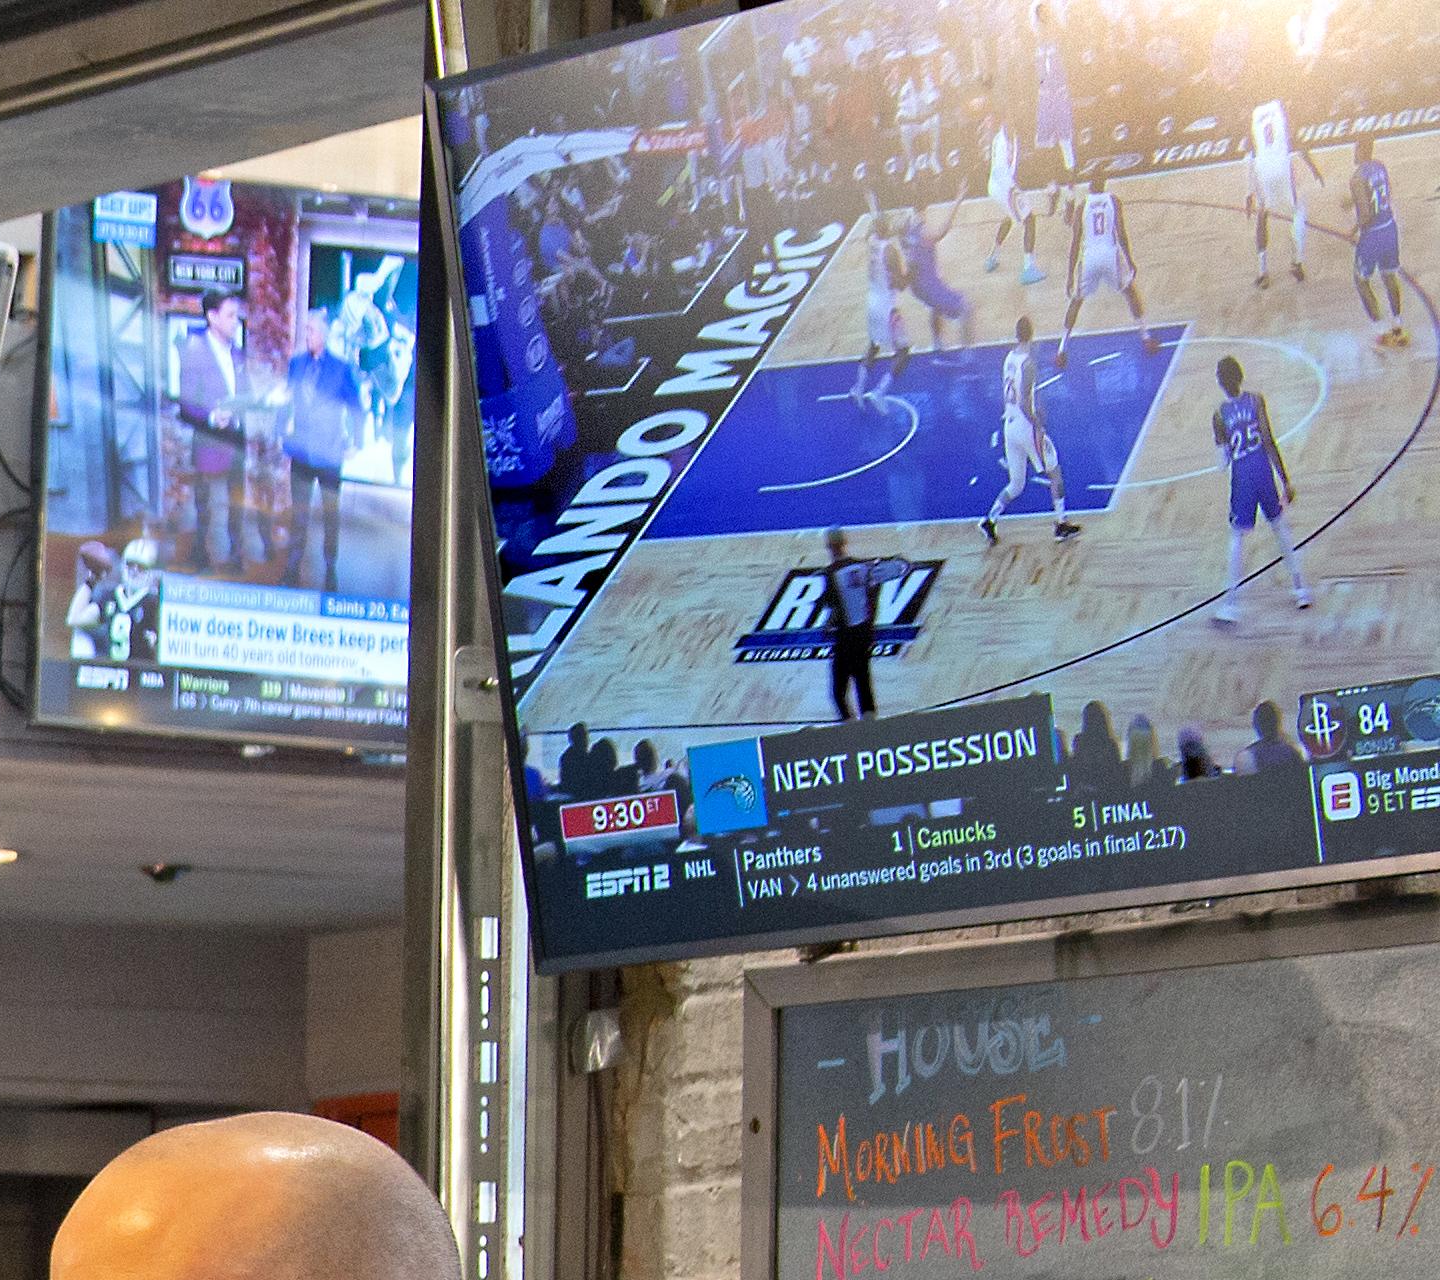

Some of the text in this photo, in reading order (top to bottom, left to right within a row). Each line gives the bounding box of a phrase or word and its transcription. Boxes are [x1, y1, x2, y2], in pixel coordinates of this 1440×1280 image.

[502, 408, 710, 692] LANDO
[653, 221, 845, 397] MAGIC
[1230, 422, 1261, 460] 25
[199, 586, 261, 606] Divisional
[327, 598, 366, 616] Saints
[369, 601, 389, 620] 20,
[764, 566, 933, 631] RV
[110, 612, 131, 661] 9
[168, 614, 202, 634] How
[207, 618, 242, 638] does
[248, 620, 289, 641] Drew
[292, 622, 335, 646] Brees
[339, 625, 376, 653] keep
[168, 638, 191, 656] Will
[194, 641, 219, 659] turn
[223, 643, 239, 660] 40
[243, 647, 274, 665] years
[278, 648, 296, 665] old
[181, 673, 230, 695] Warriors
[1359, 702, 1392, 735] 84
[773, 726, 1038, 792] NEXT POSSESSION
[1365, 769, 1393, 791] Big
[592, 799, 646, 832] 9:30
[1367, 794, 1380, 815] 9
[1383, 790, 1407, 813] ET
[743, 800, 1154, 872] Panthers 1 Canucks 5 FINAL
[685, 858, 717, 881] NHL
[749, 825, 1187, 901] VAN 4 unanswered goals in 3rd (3 goals in final 2:17)
[817, 1112, 977, 1201] MORNING
[989, 1093, 1118, 1176] FROST
[999, 1166, 1181, 1257] REMEDY
[1198, 1159, 1293, 1247] IPA
[1310, 1163, 1434, 1242] 6.4%
